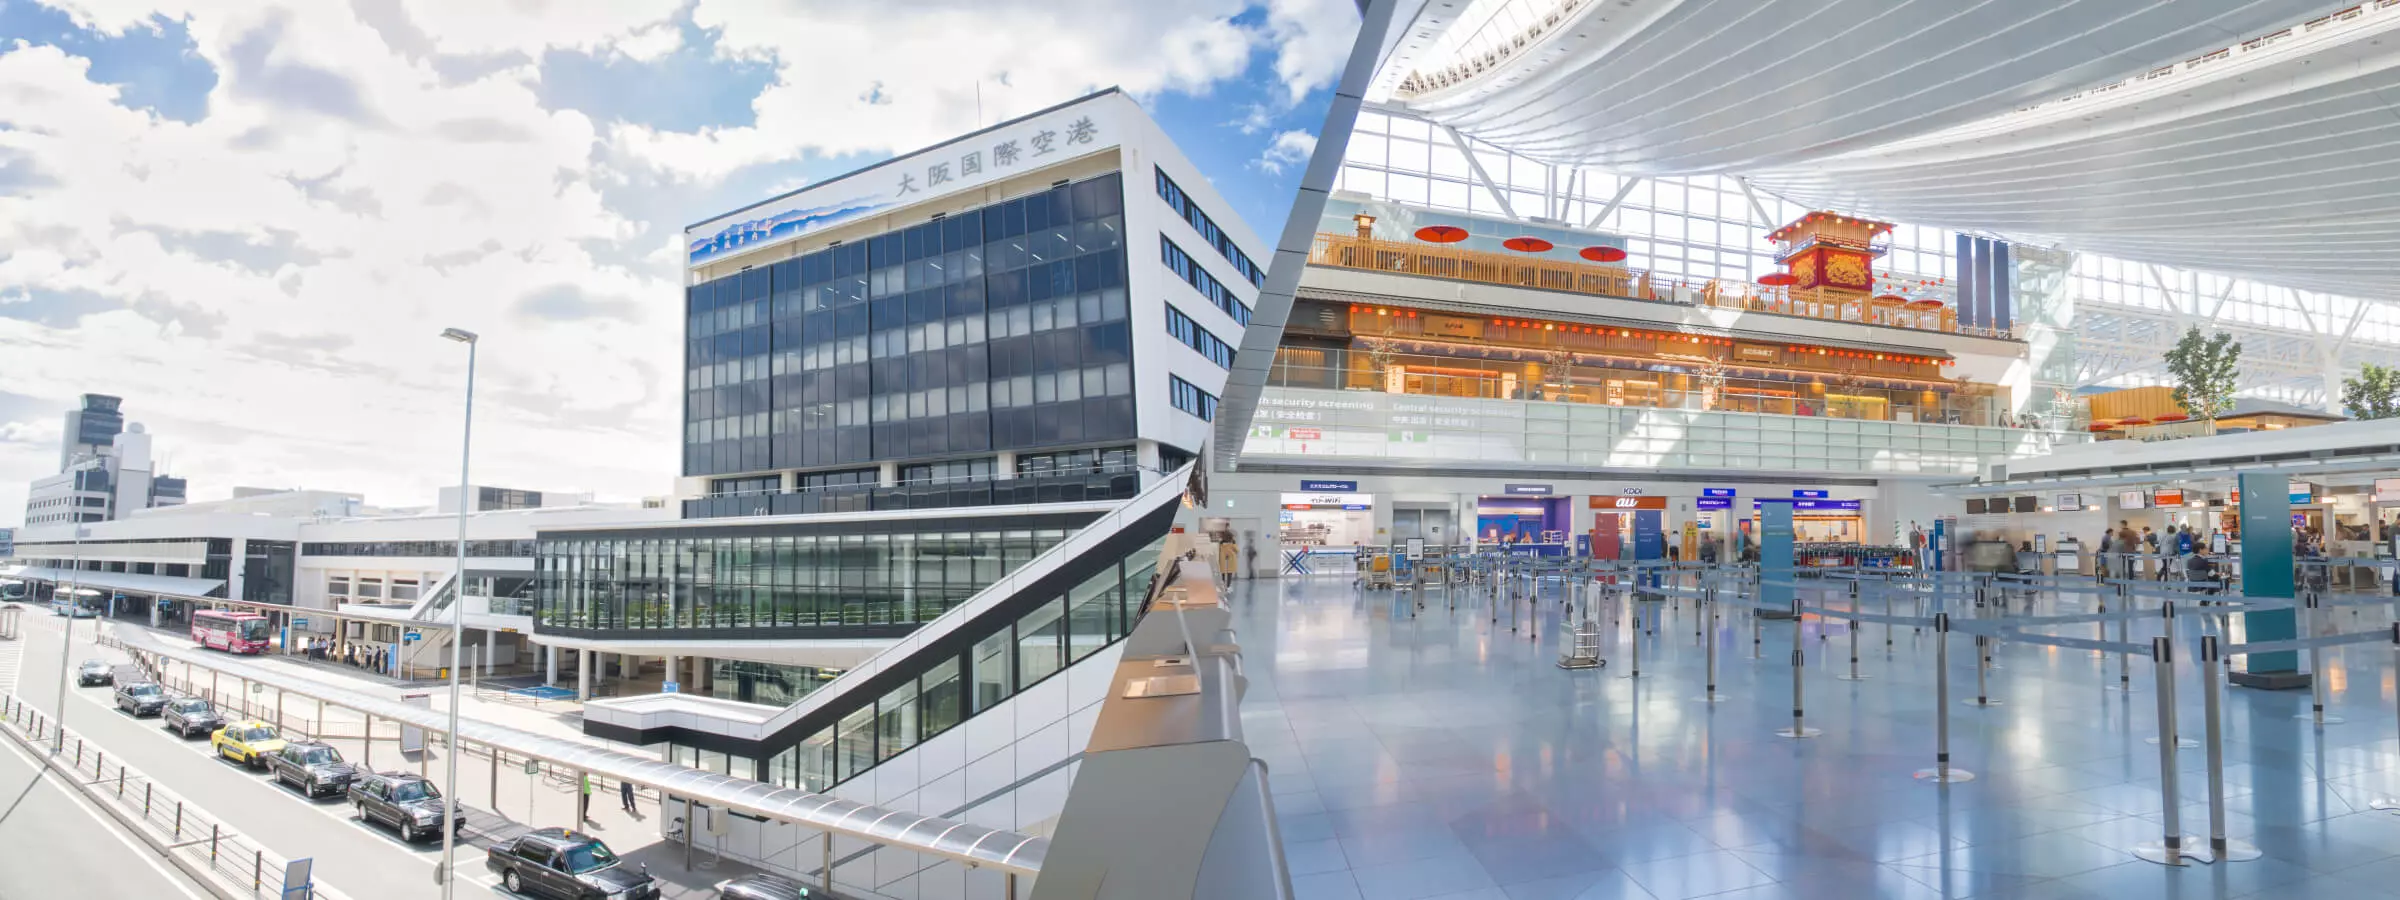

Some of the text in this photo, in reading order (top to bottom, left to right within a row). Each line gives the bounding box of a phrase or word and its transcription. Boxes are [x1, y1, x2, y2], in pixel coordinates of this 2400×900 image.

[896, 115, 1099, 198] 大阪国際空港
[1271, 398, 1316, 408] security
[1318, 401, 1374, 410] screening
[1392, 402, 1427, 412] Central
[1623, 487, 1643, 495] KDDI
[1615, 497, 1639, 508] au
